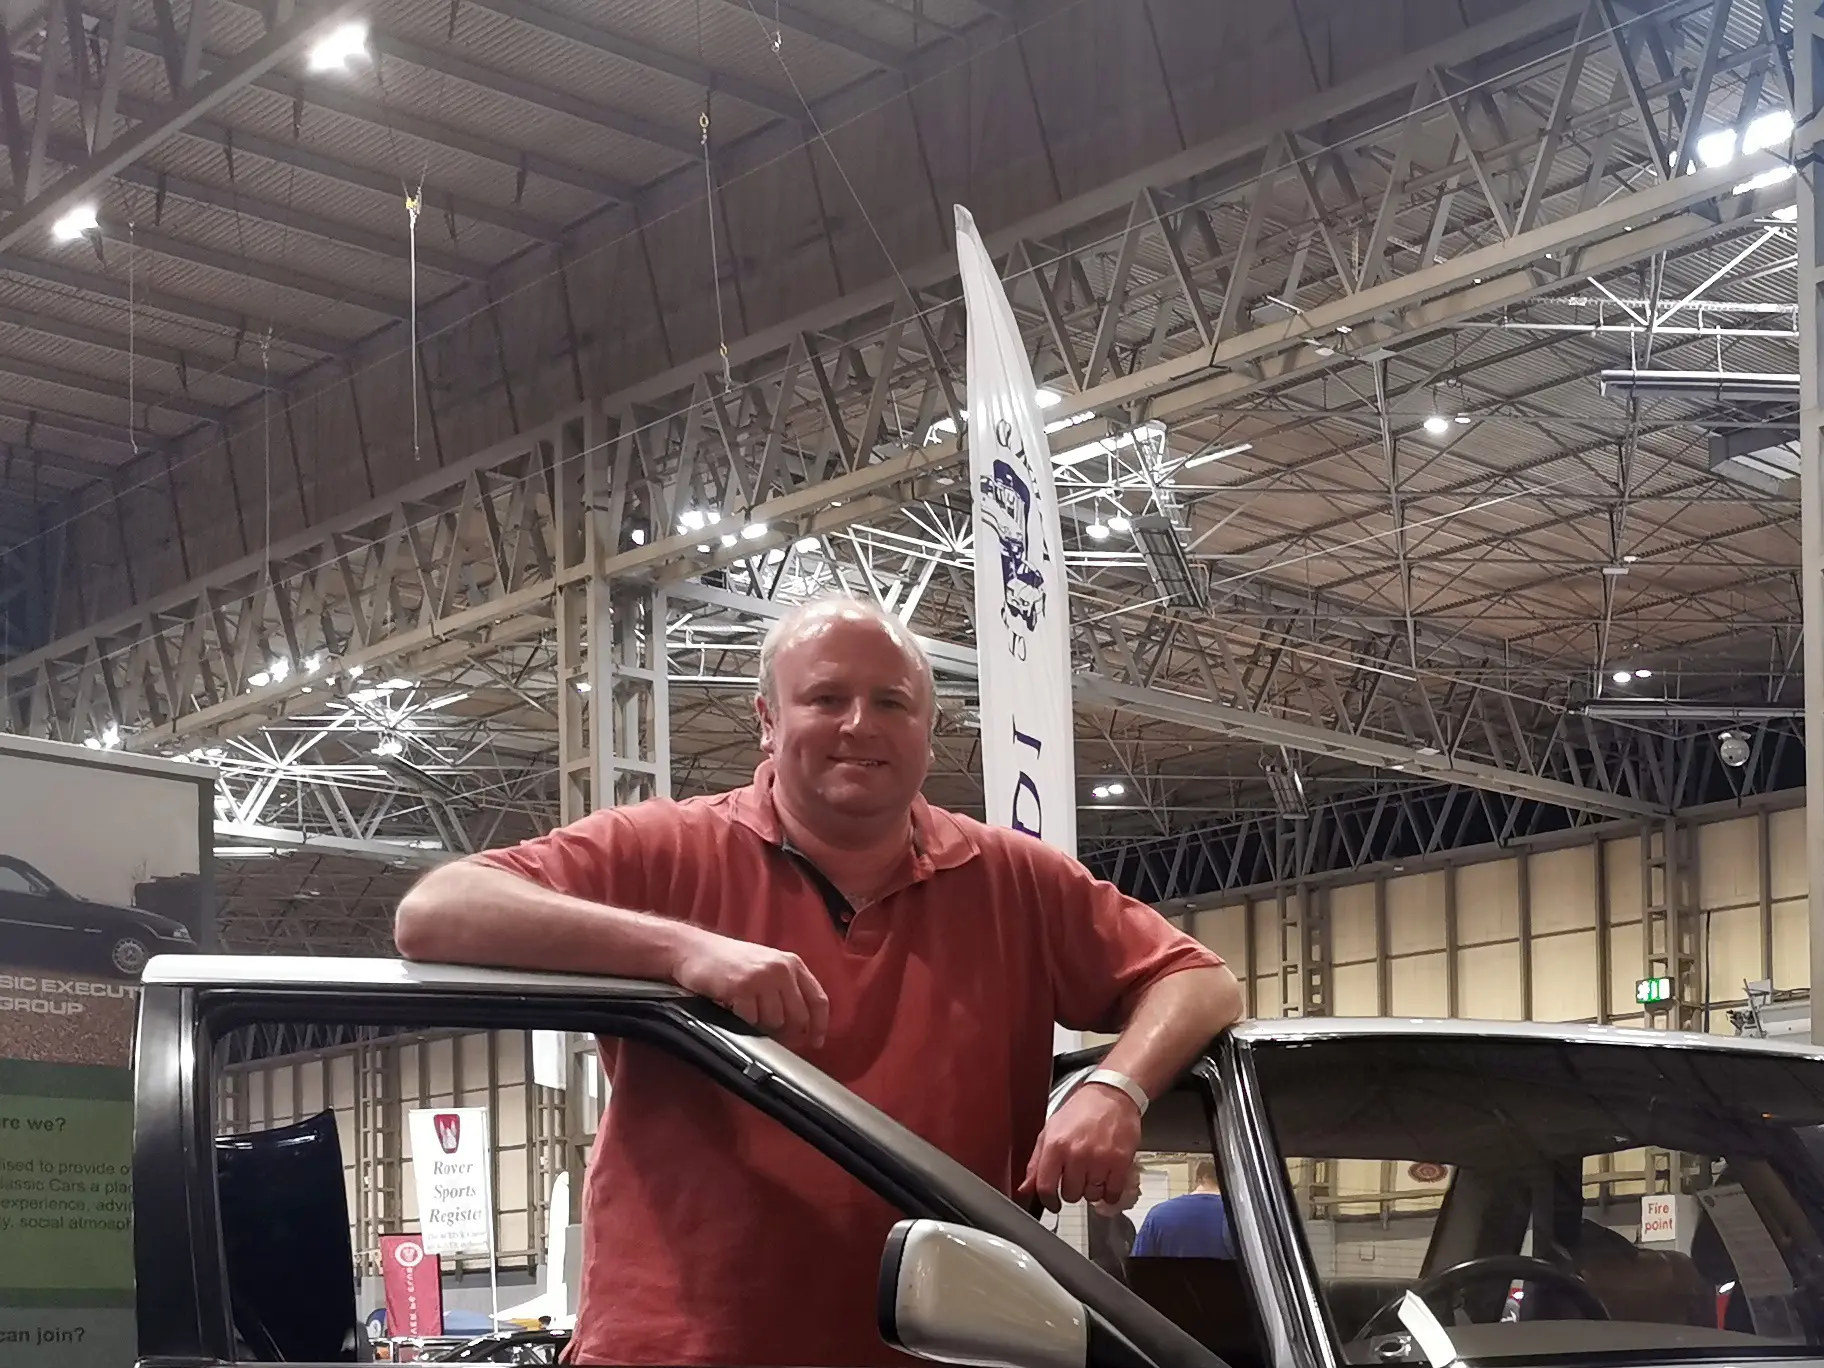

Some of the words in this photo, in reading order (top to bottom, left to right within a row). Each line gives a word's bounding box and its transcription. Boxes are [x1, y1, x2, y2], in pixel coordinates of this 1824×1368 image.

[26, 1117, 66, 1132] we?
[39, 1160, 54, 1173] to
[58, 1162, 116, 1176] provide
[433, 1160, 474, 1175] Rover
[49, 1178, 86, 1193] Cars
[434, 1184, 477, 1203] Sports
[1648, 1203, 1669, 1214] Fire
[1645, 1218, 1673, 1235] point
[36, 1326, 85, 1346] join?
